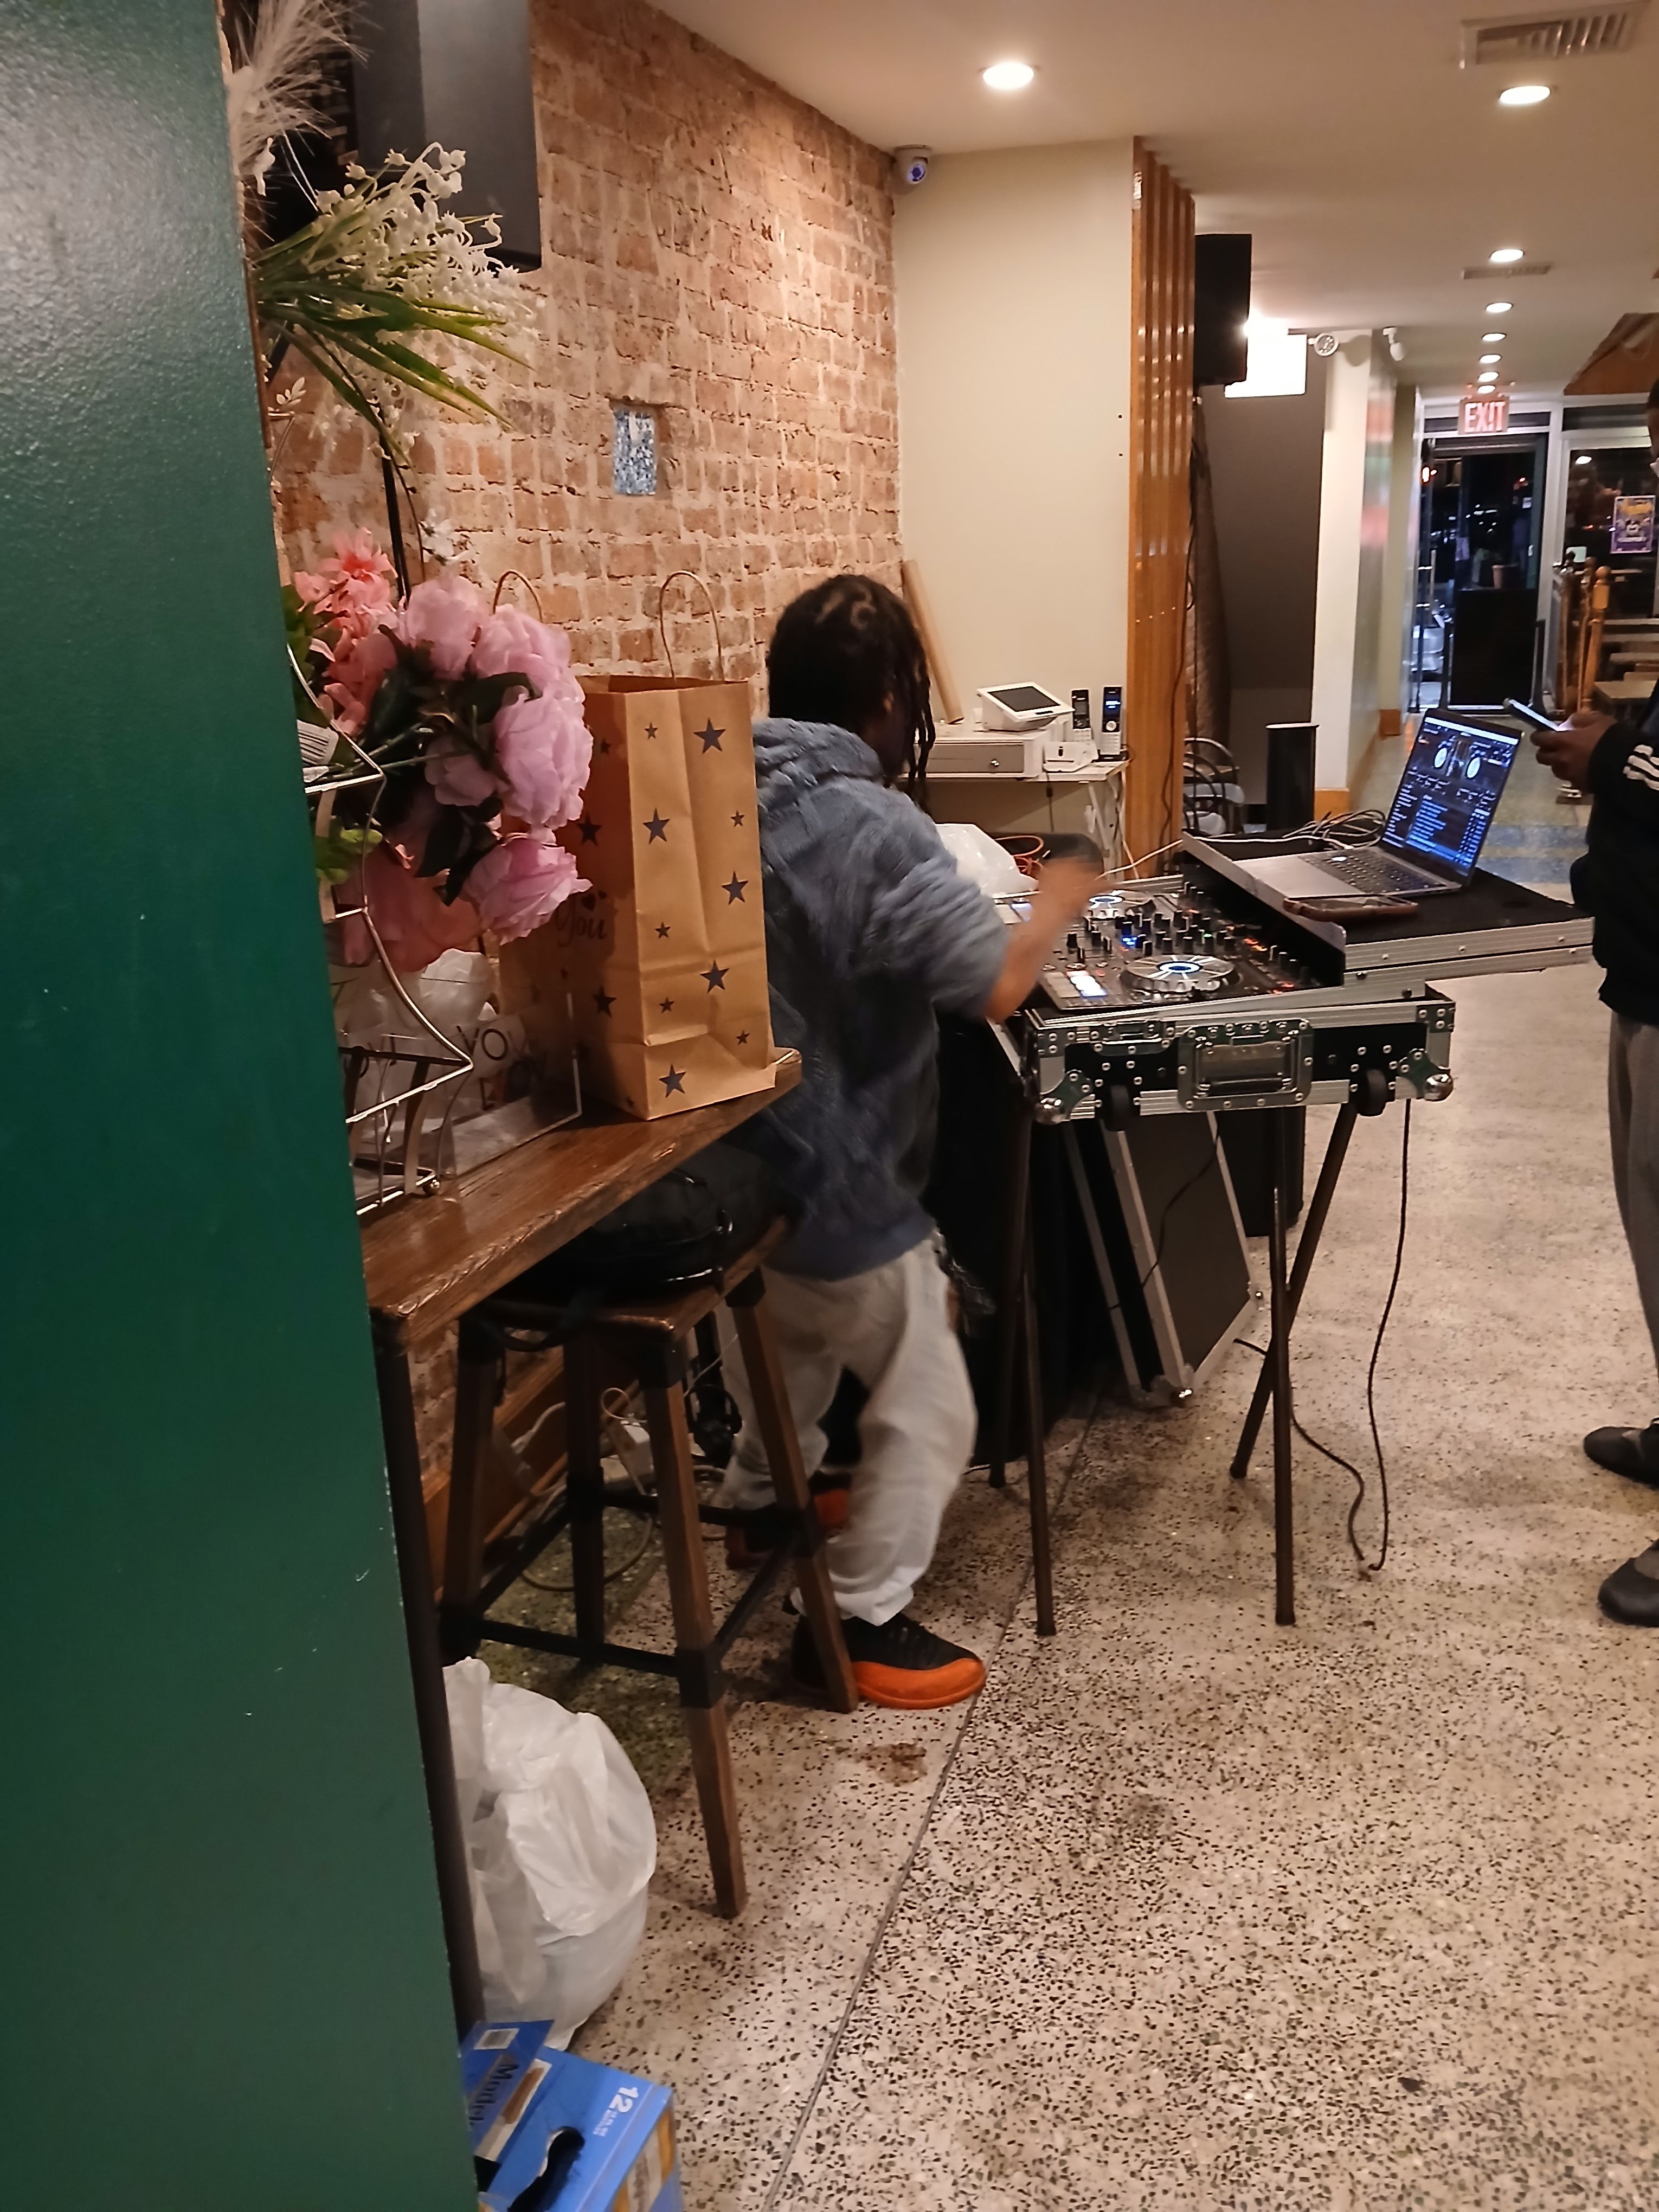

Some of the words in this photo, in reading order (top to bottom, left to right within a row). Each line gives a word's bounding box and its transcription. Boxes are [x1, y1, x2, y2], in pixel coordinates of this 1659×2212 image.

[1465, 401, 1506, 432] EXIT
[469, 2064, 520, 2126] Model
[609, 2087, 639, 2113] 12
